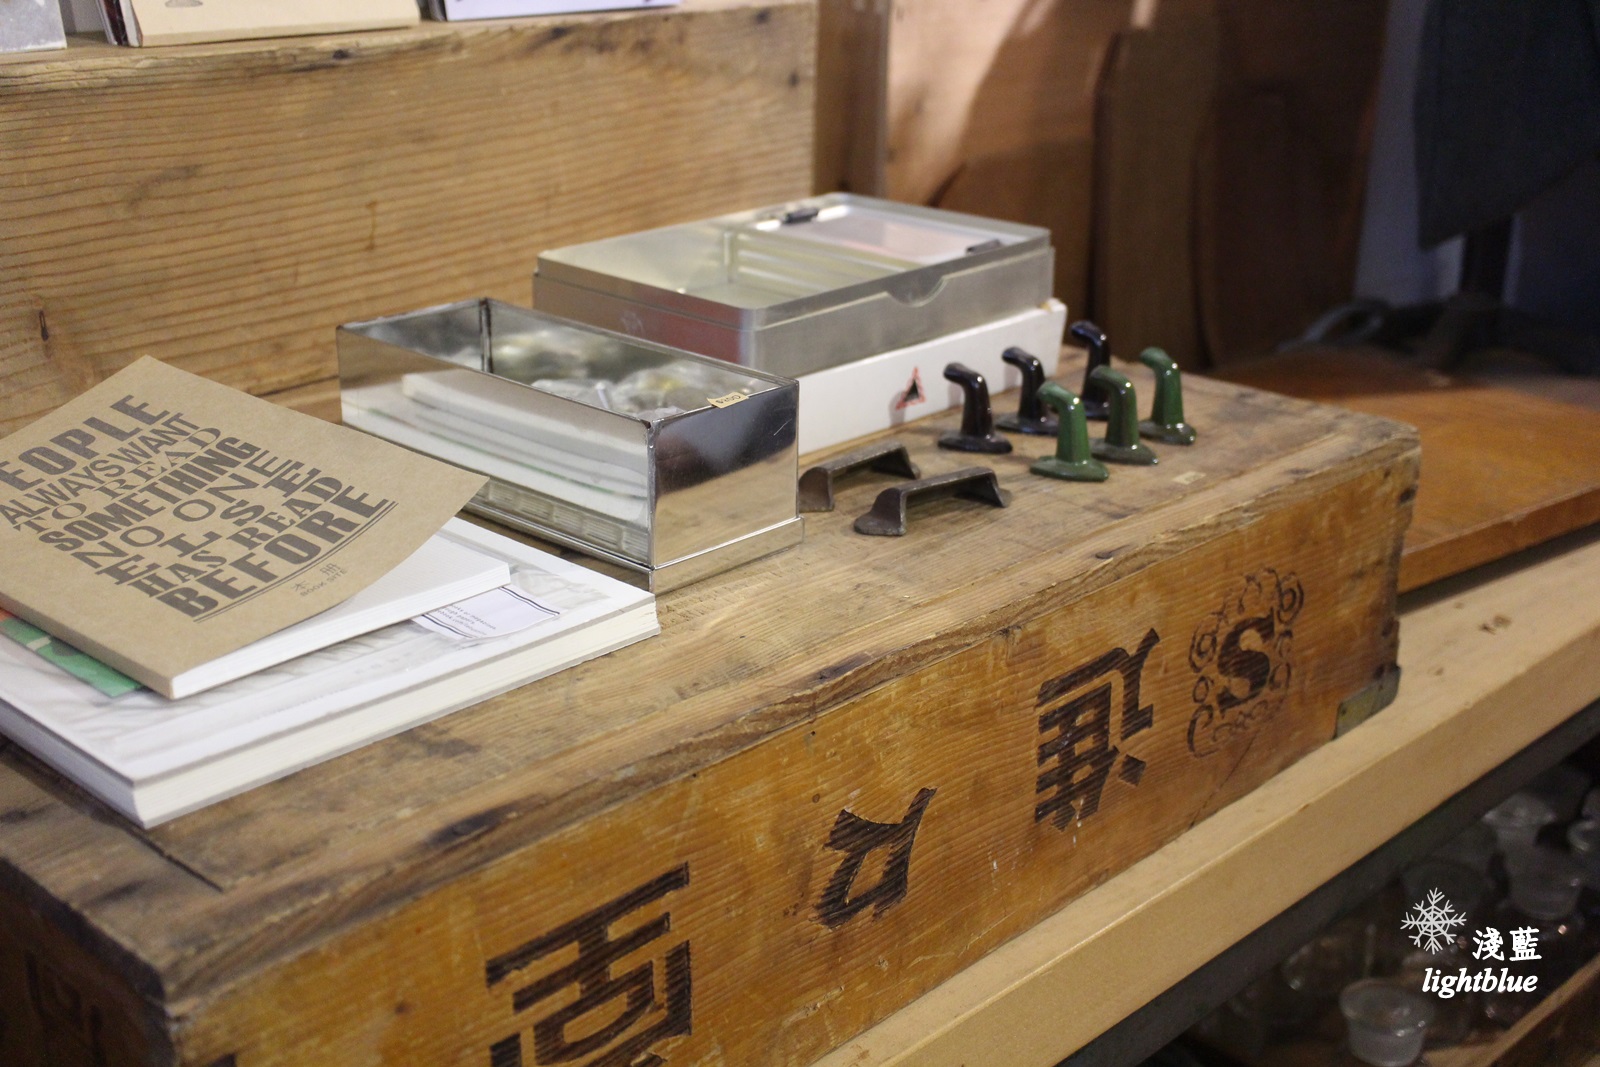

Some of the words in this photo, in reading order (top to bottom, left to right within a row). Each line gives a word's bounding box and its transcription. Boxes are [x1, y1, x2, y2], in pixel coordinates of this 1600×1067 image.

[0, 459, 126, 525] ALWAYS
[107, 412, 201, 465] WANT
[13, 502, 88, 535] TO
[93, 427, 221, 500] READ
[38, 437, 262, 551] SOMETHING
[70, 525, 165, 569] NO
[172, 450, 293, 522] ONE
[95, 461, 322, 586] ELSE
[127, 549, 227, 598] HAS
[226, 476, 343, 550] READ
[156, 485, 389, 617] BEFORE
